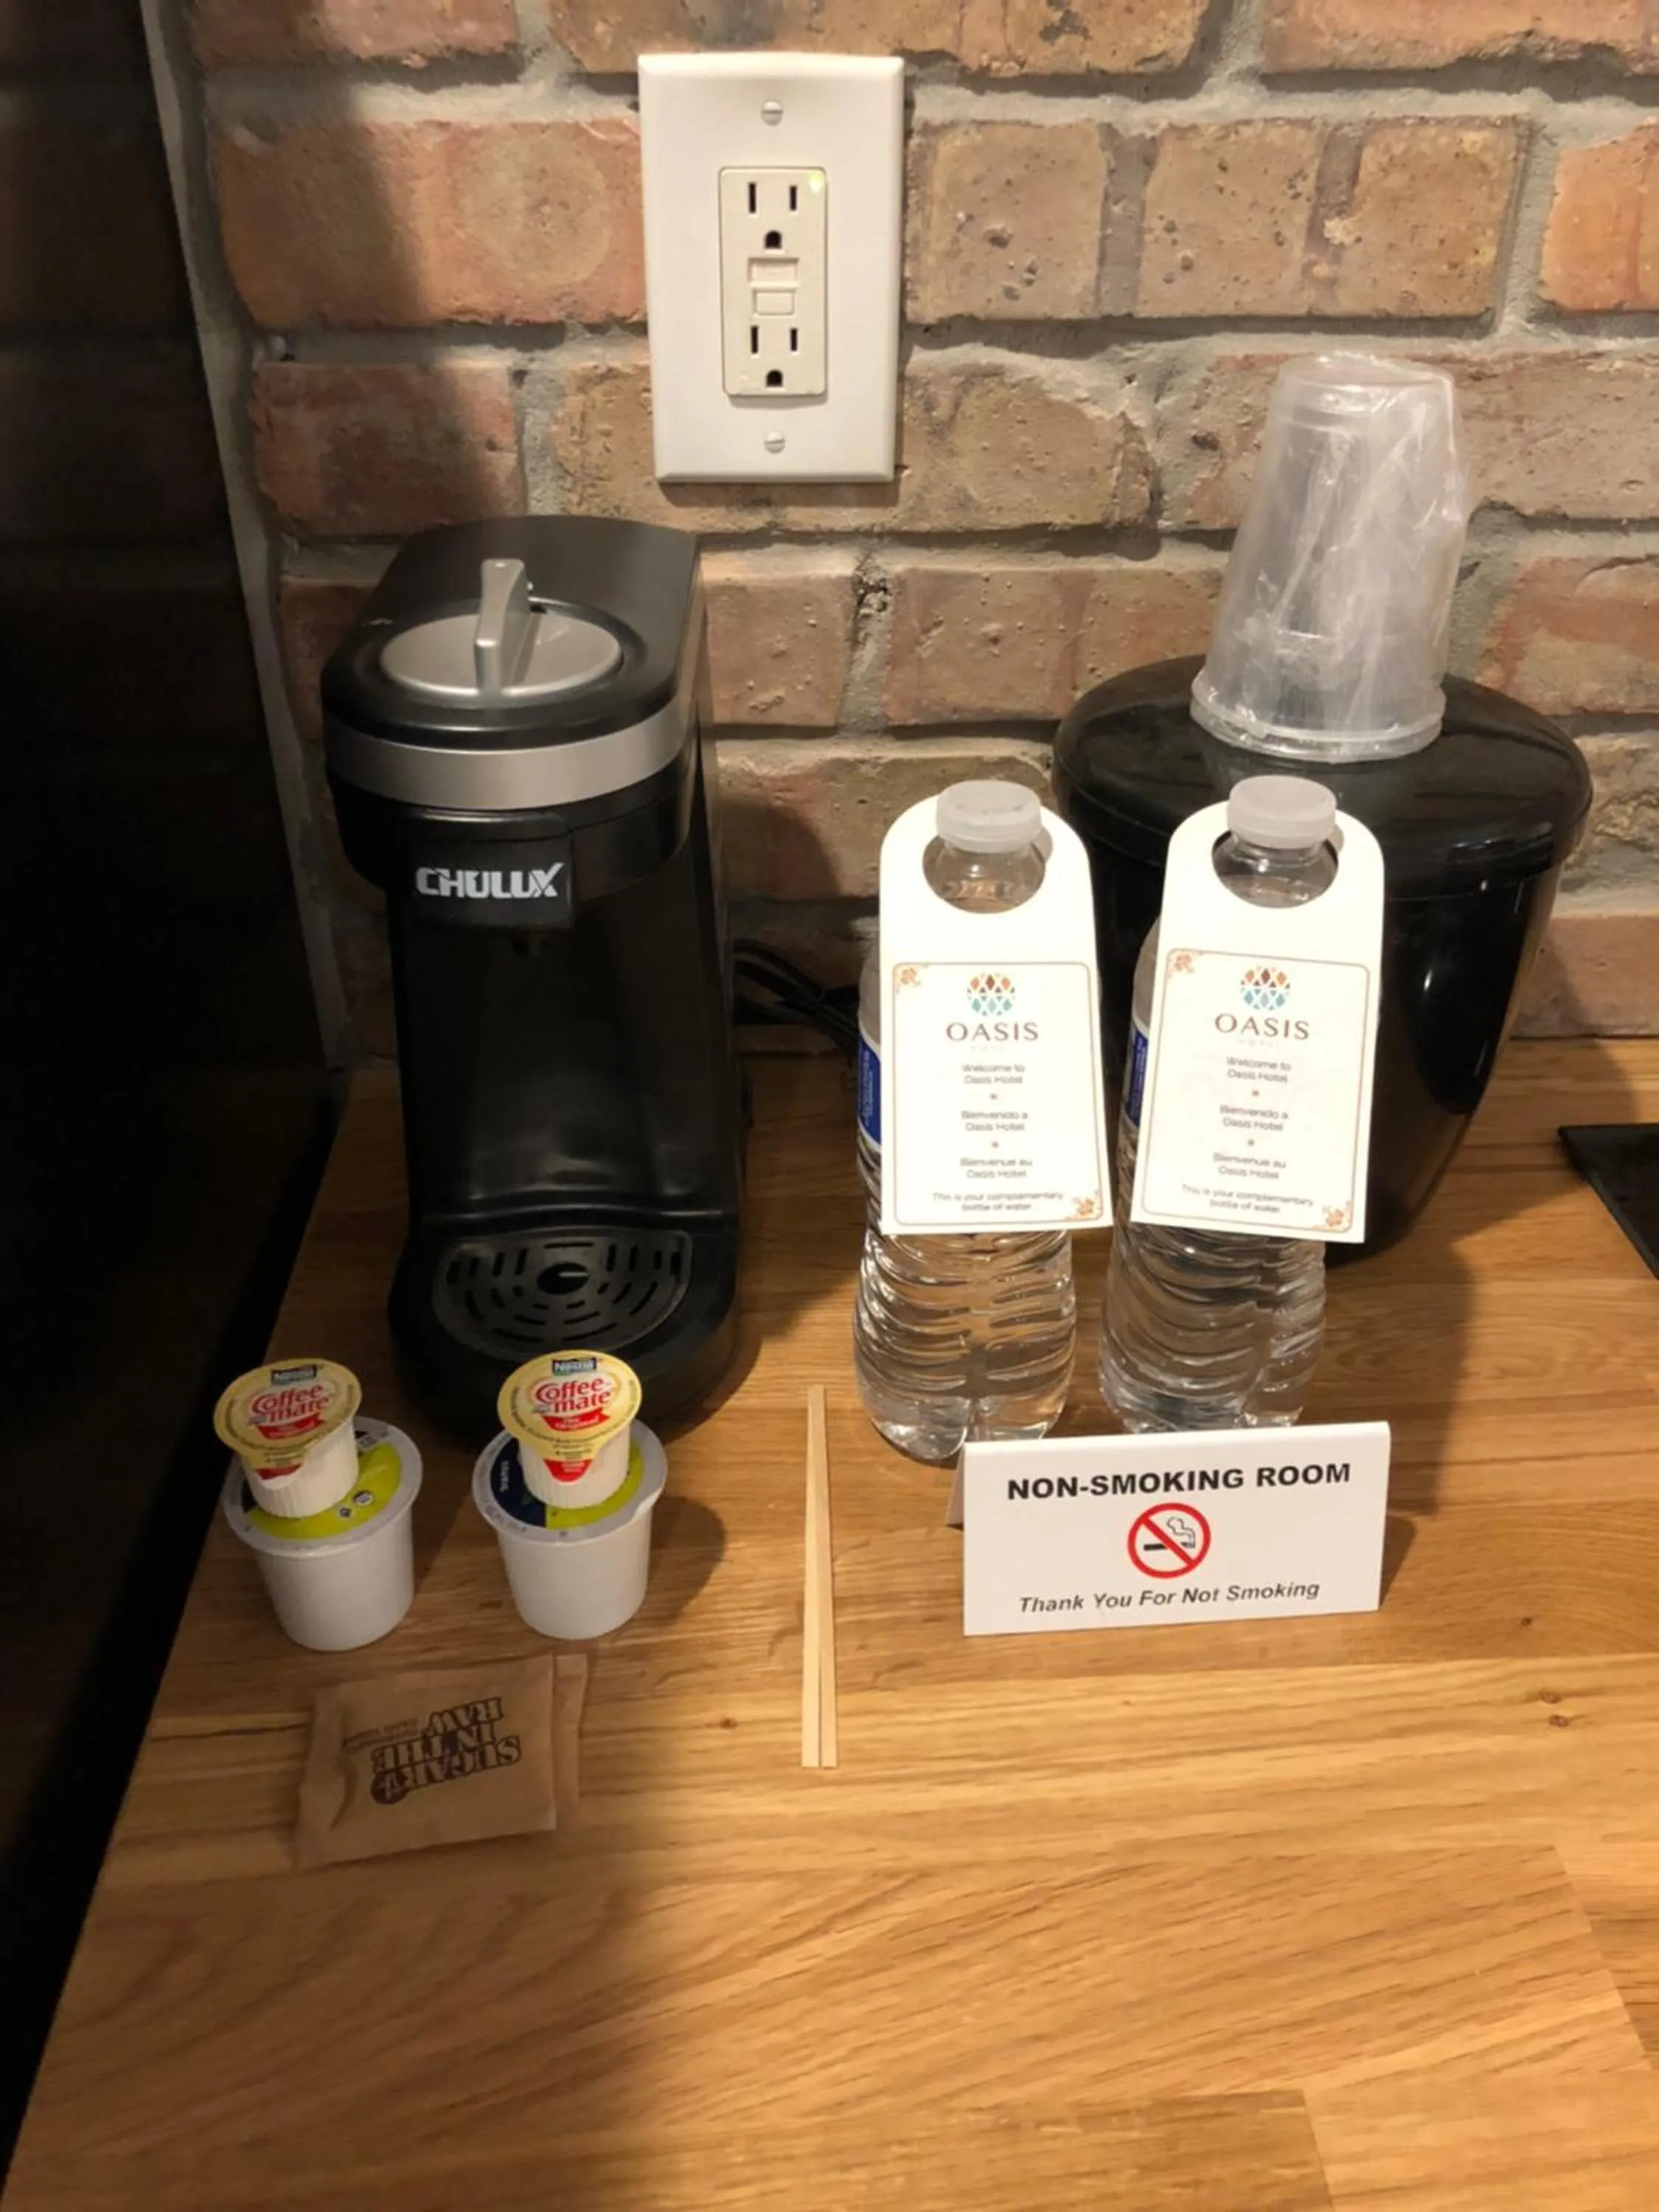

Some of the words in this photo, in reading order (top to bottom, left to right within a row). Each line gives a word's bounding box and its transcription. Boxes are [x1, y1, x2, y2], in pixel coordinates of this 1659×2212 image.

[416, 862, 565, 899] CHULUX
[946, 1022, 1040, 1042] OASIS
[1214, 1013, 1310, 1040] OASIS
[961, 1063, 1012, 1073] Welcome
[1014, 1063, 1026, 1073] to
[1226, 1056, 1277, 1069] Welcome
[1280, 1062, 1291, 1071] to
[964, 1075, 992, 1084] Oasis
[995, 1075, 1023, 1084] Hotel
[1227, 1068, 1256, 1080] Oasis
[1258, 1072, 1287, 1083] Hotel
[961, 1110, 1019, 1119] Bienvenido
[1220, 1105, 1279, 1119] Bienvenido
[965, 1122, 993, 1131] Oasis
[995, 1122, 1024, 1131] Hotel
[1222, 1116, 1251, 1128] Oasis
[1254, 1121, 1283, 1131] Hotel
[960, 1158, 1017, 1166] Bienvenue
[1214, 1152, 1270, 1166] Bienvenue
[967, 1169, 995, 1178] Oasis
[998, 1169, 1027, 1178] Hotel
[1218, 1166, 1248, 1178] Oasis
[1249, 1169, 1279, 1179] Hotel
[932, 1192, 951, 1201] This
[964, 1193, 984, 1201] your
[961, 1203, 991, 1212] bottle
[535, 1377, 604, 1403] Coffee
[251, 1384, 323, 1415] Coffee
[554, 1391, 611, 1413] mate
[269, 1397, 330, 1422] mate
[1007, 1468, 1244, 1500] NON-SMOKING
[1256, 1463, 1351, 1487] ROOM
[1020, 1594, 1085, 1613] Thank
[1093, 1593, 1132, 1608] You
[1138, 1590, 1176, 1607] For
[1182, 1587, 1220, 1604] Not
[1226, 1582, 1321, 1601] Smoking
